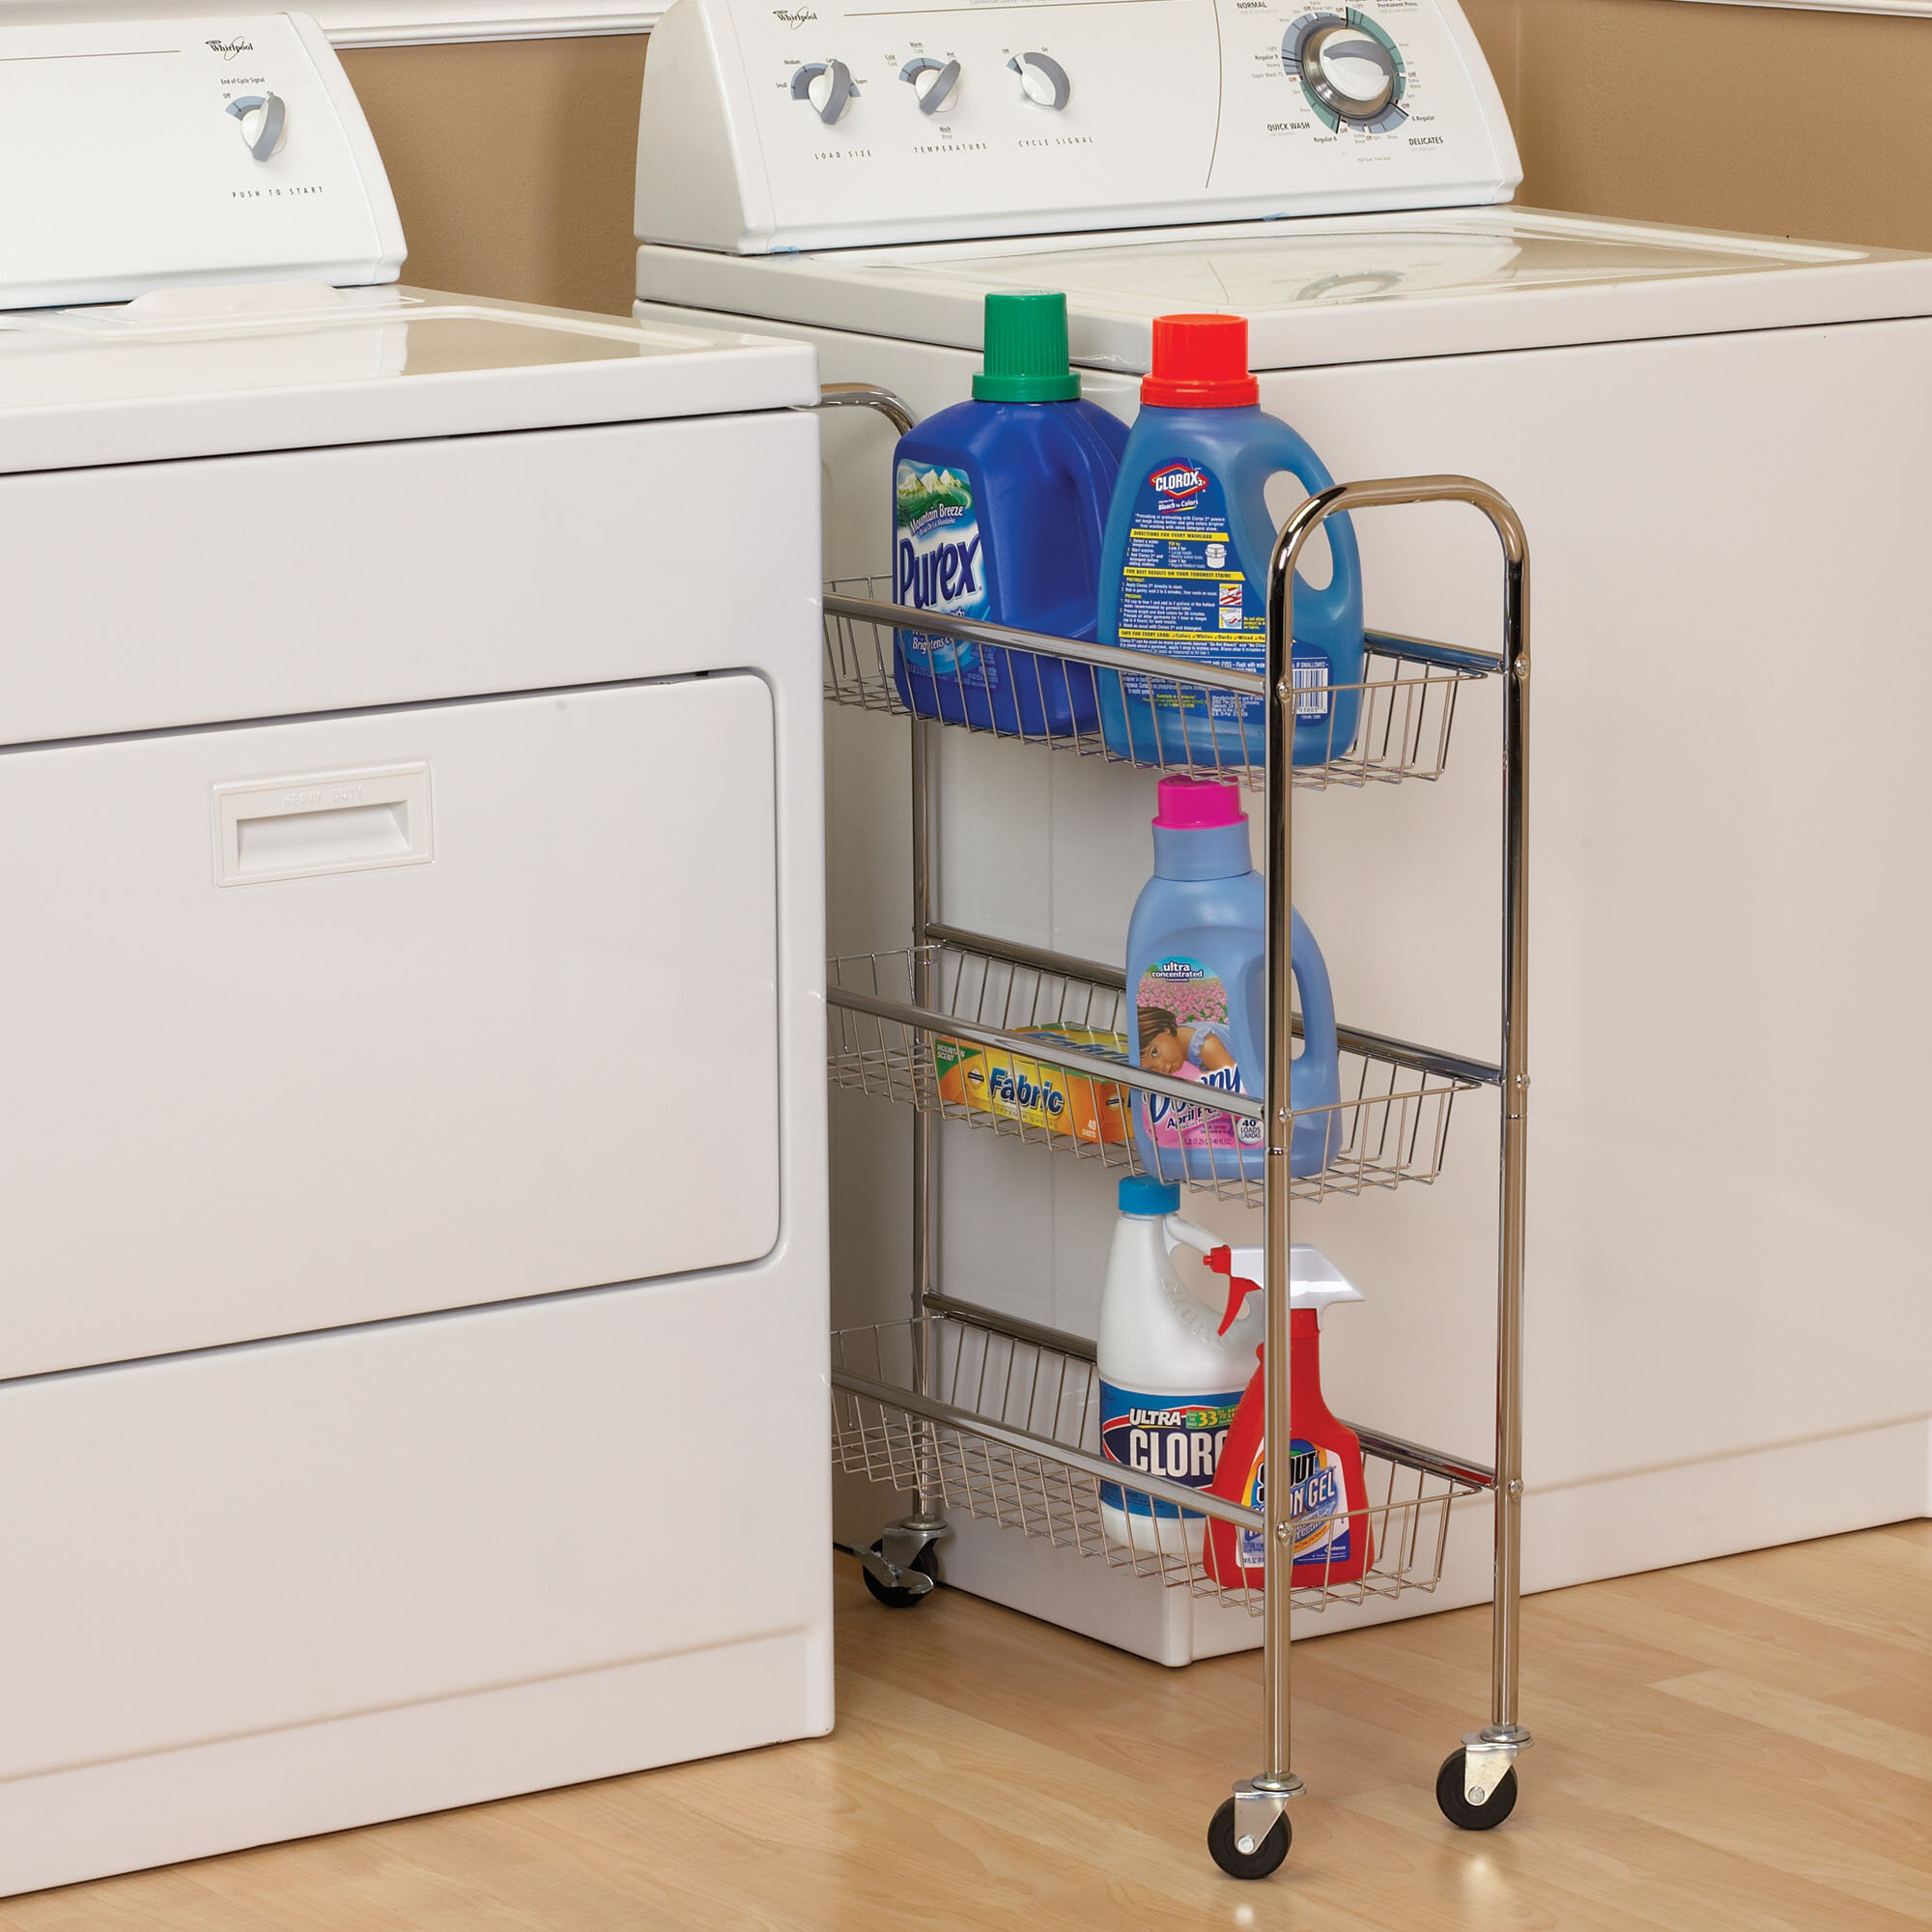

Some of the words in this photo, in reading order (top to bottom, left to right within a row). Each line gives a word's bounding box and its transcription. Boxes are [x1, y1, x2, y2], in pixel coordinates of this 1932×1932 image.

[777, 12, 818, 23] Whirlpool
[209, 42, 254, 55] Whirlpool
[249, 76, 266, 85] Signal
[1266, 124, 1289, 132] QUICK
[1290, 122, 1311, 130] WASH
[914, 142, 988, 154] TEMPERATURE
[1018, 140, 1050, 149] CYCLE
[1055, 136, 1094, 146] SIGNAL
[1408, 137, 1444, 146] DELICATES
[814, 152, 842, 161] LOAD
[848, 150, 872, 158] SIZE
[289, 186, 324, 196] START
[1155, 471, 1199, 492] CLOROX
[1158, 502, 1176, 511] Bleach
[1180, 498, 1199, 507] Colors
[910, 506, 939, 534] Mountain
[938, 503, 964, 519] Breeze
[899, 533, 981, 611] Purex
[912, 637, 945, 655] Brigtens
[285, 788, 322, 806] HEAVY
[331, 784, 363, 802] DUTY
[1162, 961, 1191, 972] ultra
[1151, 970, 1204, 979] concentrated
[937, 1044, 966, 1059] MOUNTN
[937, 1051, 955, 1063] SCENT
[989, 1066, 1065, 1116] Fabric
[1088, 1119, 1096, 1131] 40
[1167, 1108, 1195, 1130] April
[1242, 1119, 1258, 1127] 40
[1129, 1407, 1181, 1426] ULTRA
[1308, 1470, 1336, 1508] GEL
